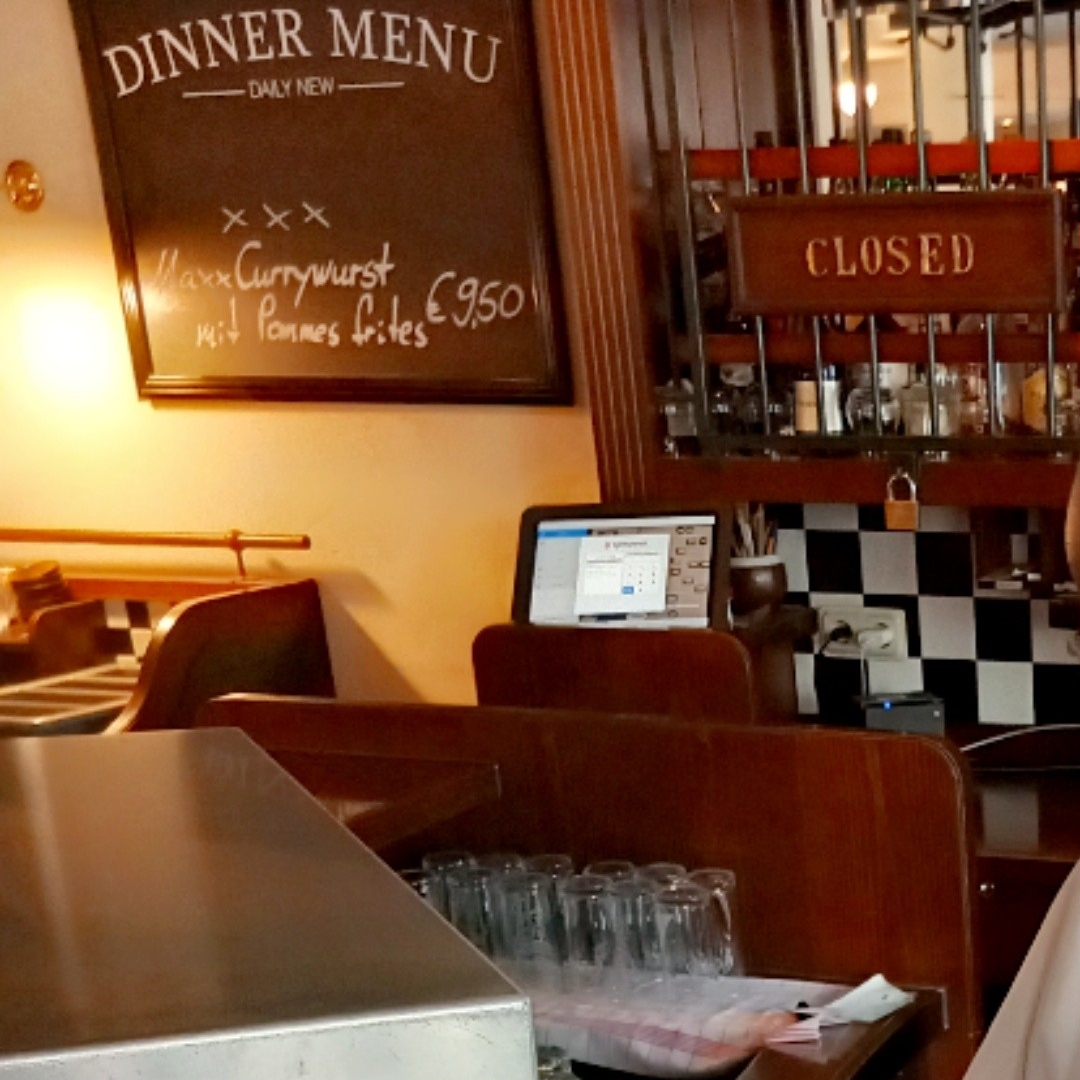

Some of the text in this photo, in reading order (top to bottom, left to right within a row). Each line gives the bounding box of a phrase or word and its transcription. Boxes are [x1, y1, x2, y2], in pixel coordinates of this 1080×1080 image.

[102, 7, 502, 98] DINNER MENU
[248, 76, 335, 99] DAILY NEW
[805, 232, 975, 277] CLOSED
